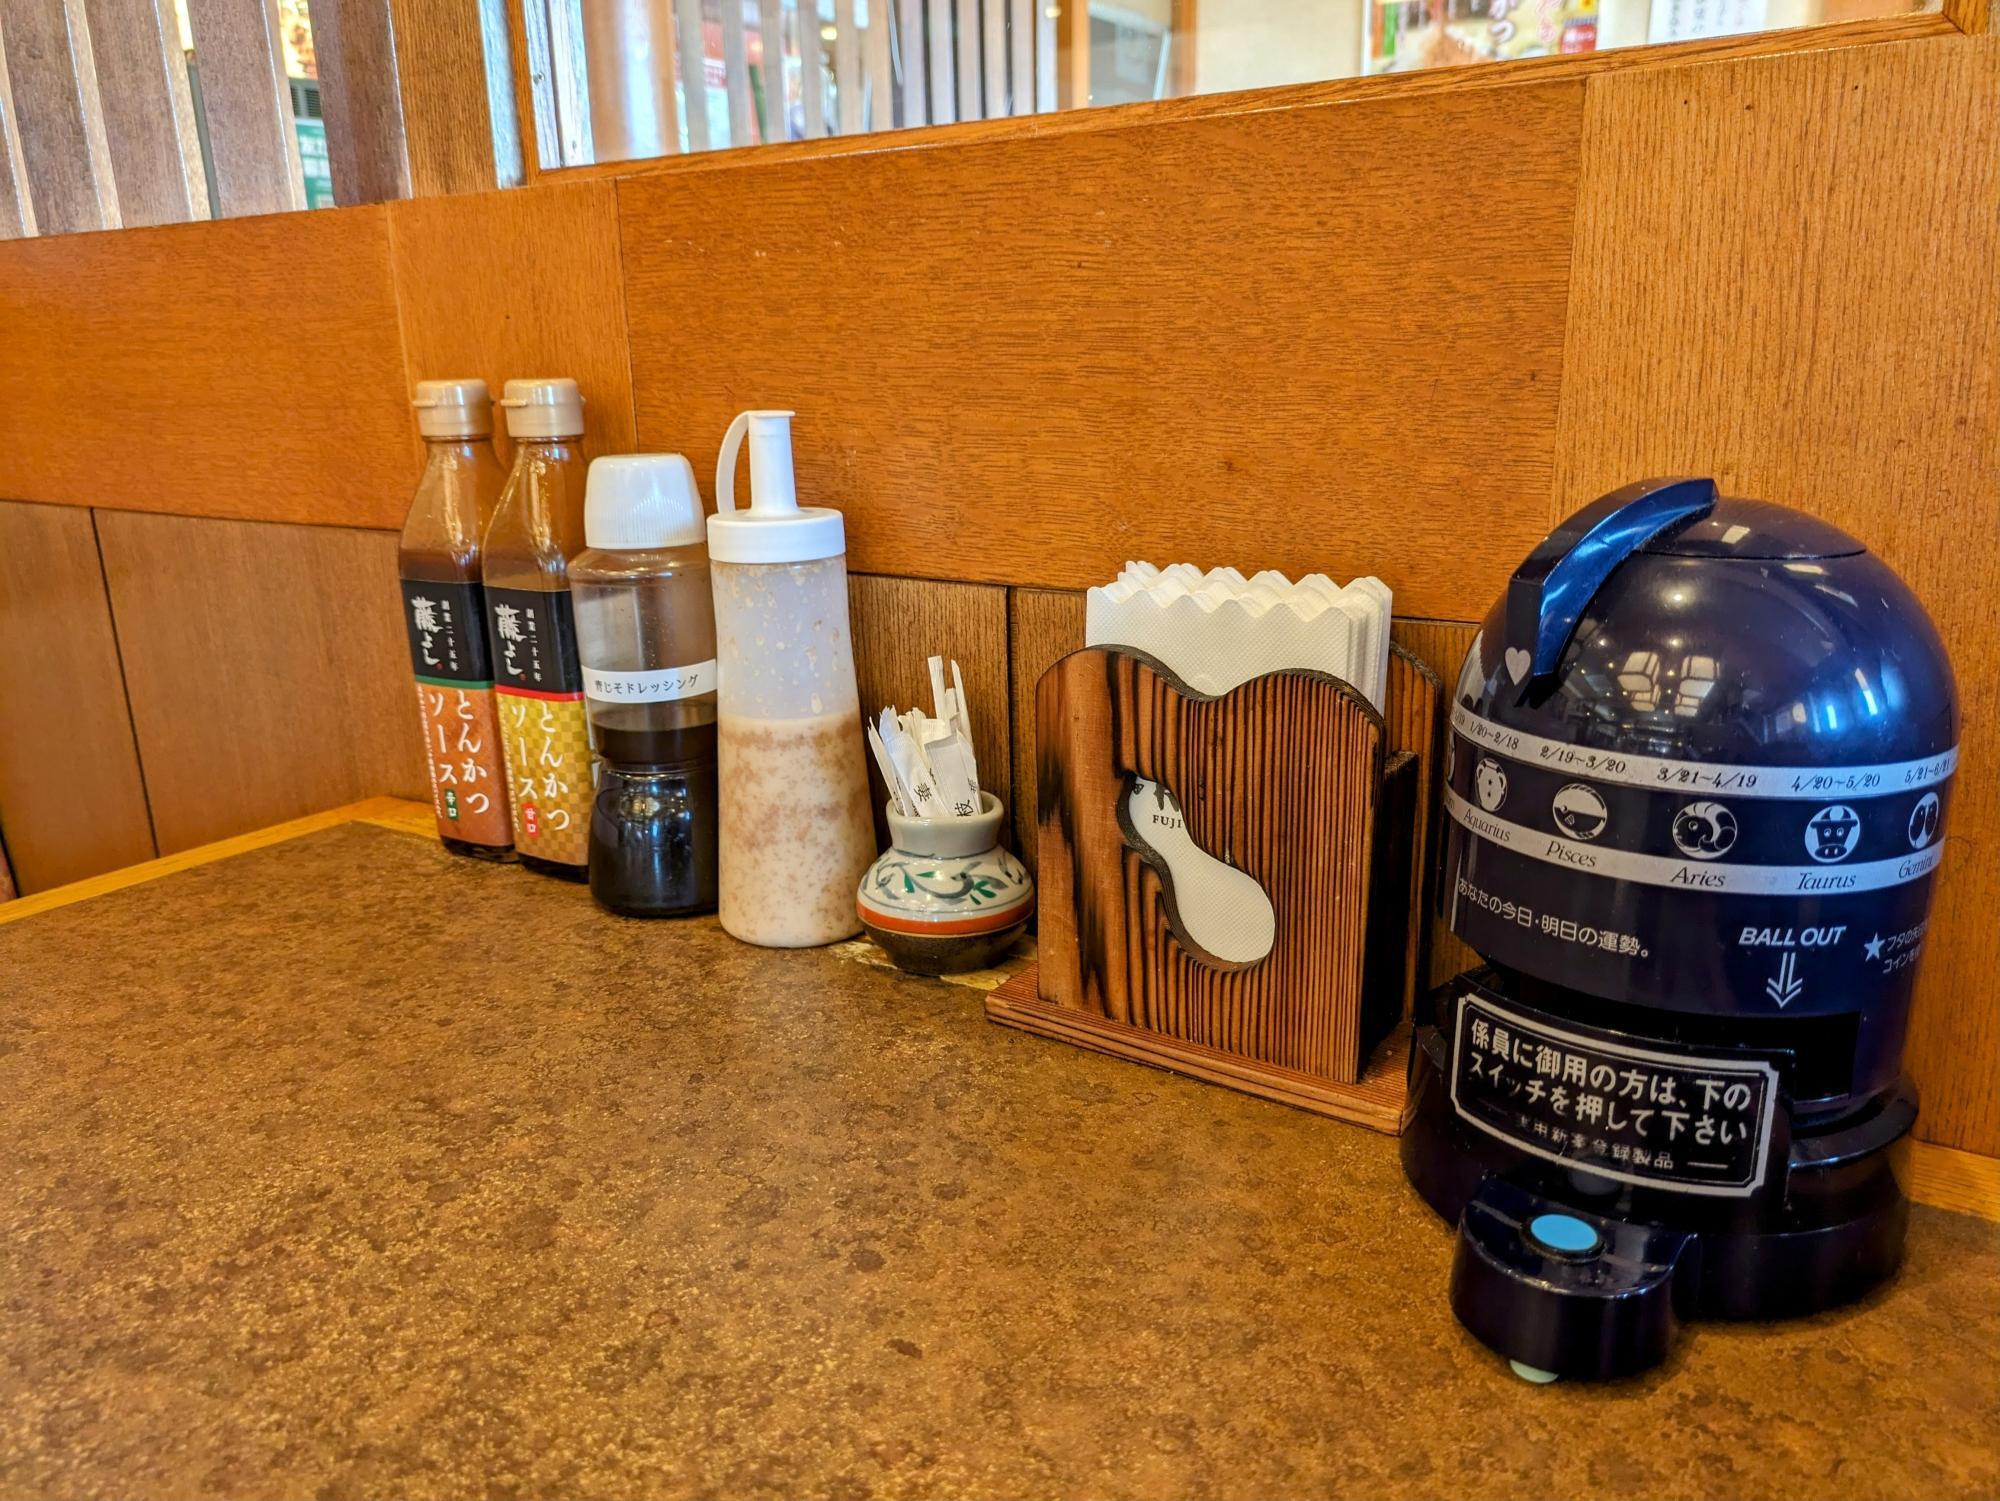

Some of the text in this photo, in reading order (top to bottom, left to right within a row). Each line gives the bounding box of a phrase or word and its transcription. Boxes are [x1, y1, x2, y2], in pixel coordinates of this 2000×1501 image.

[429, 692, 458, 784] ソース
[458, 689, 490, 814] とんかつ
[511, 704, 538, 800] ソース
[540, 701, 570, 831] とんかつ
[446, 791, 457, 818] 辛口
[525, 808, 536, 833] 甘口
[1152, 814, 1182, 829] FUJI
[1463, 807, 1934, 890] Aquarius Pisces Aries Taurus Gemini
[1738, 926, 1847, 946] BALL OUT
[1468, 1052, 1749, 1145] スイッチを押して下さい
